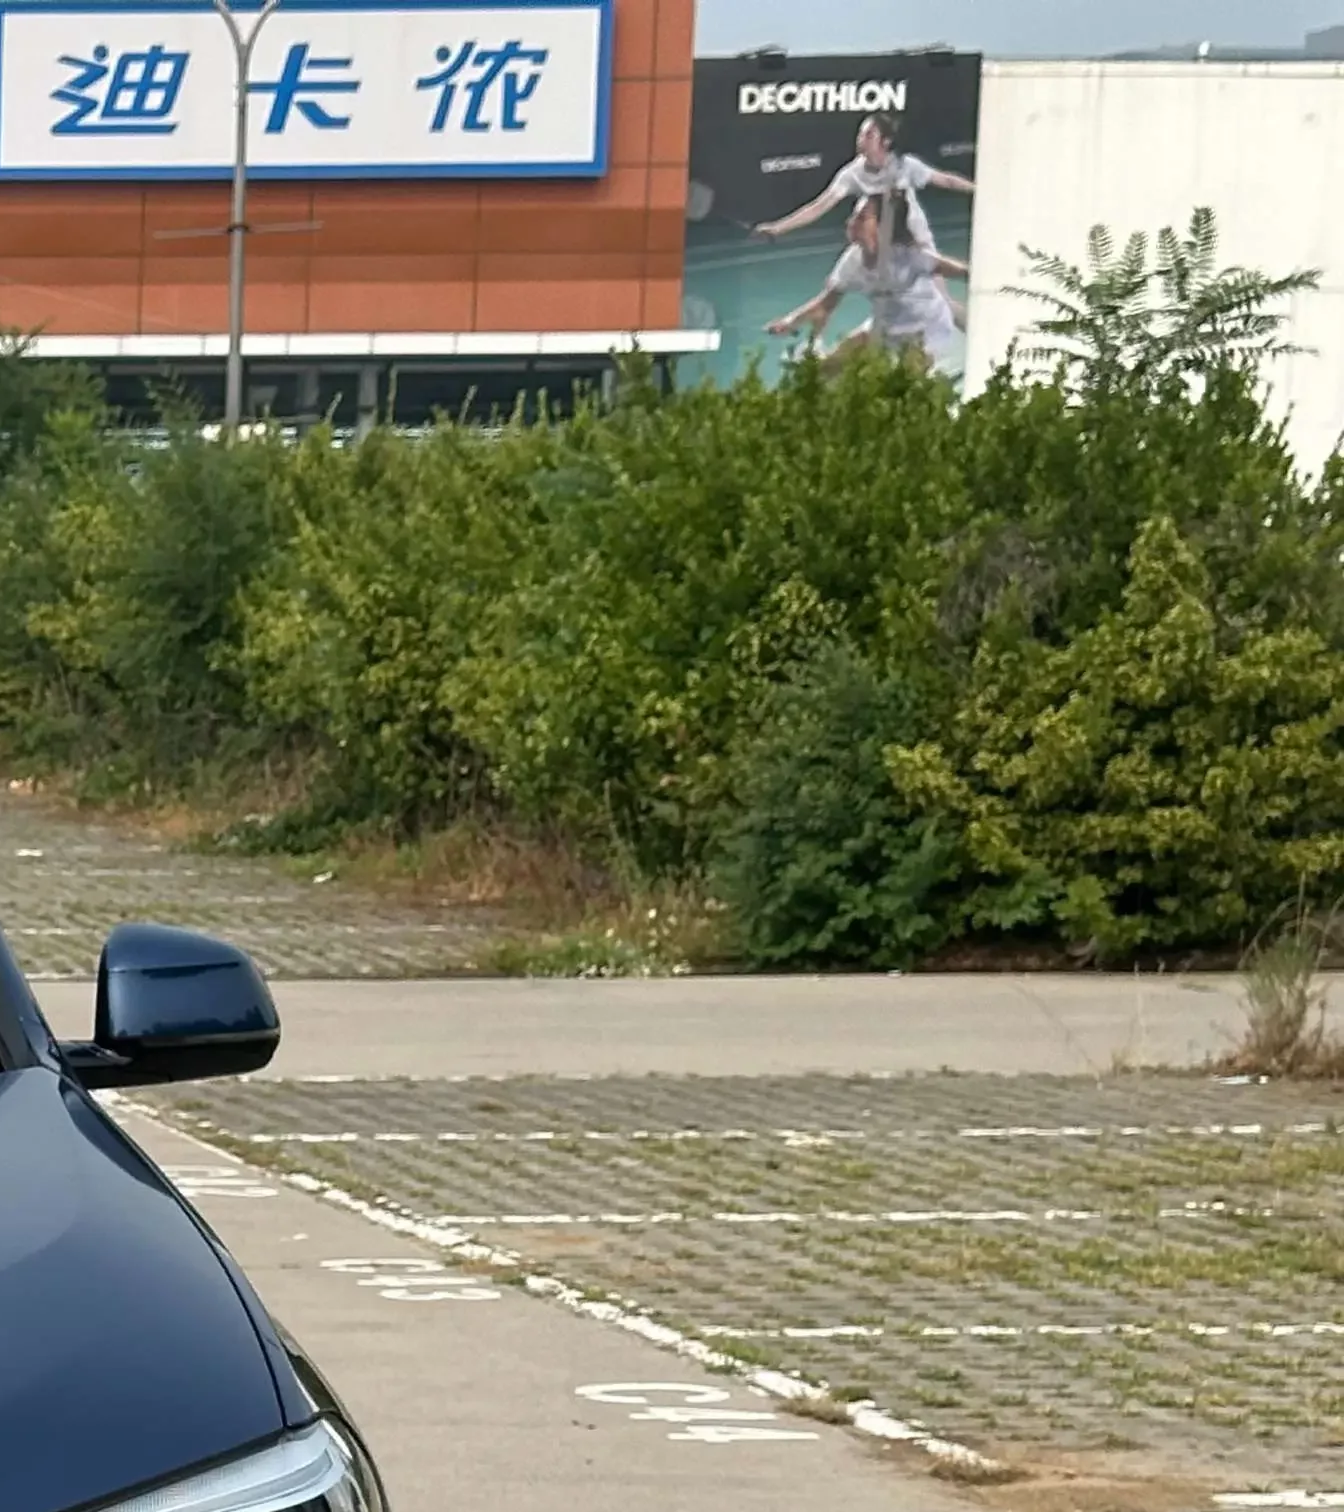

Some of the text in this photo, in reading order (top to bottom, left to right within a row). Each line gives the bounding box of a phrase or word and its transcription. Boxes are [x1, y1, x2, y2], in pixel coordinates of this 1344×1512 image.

[49, 40, 549, 135] 迪卡侬
[739, 80, 908, 113] DECATHLON
[320, 1257, 502, 1300] C43
[574, 1382, 820, 1442] C44
